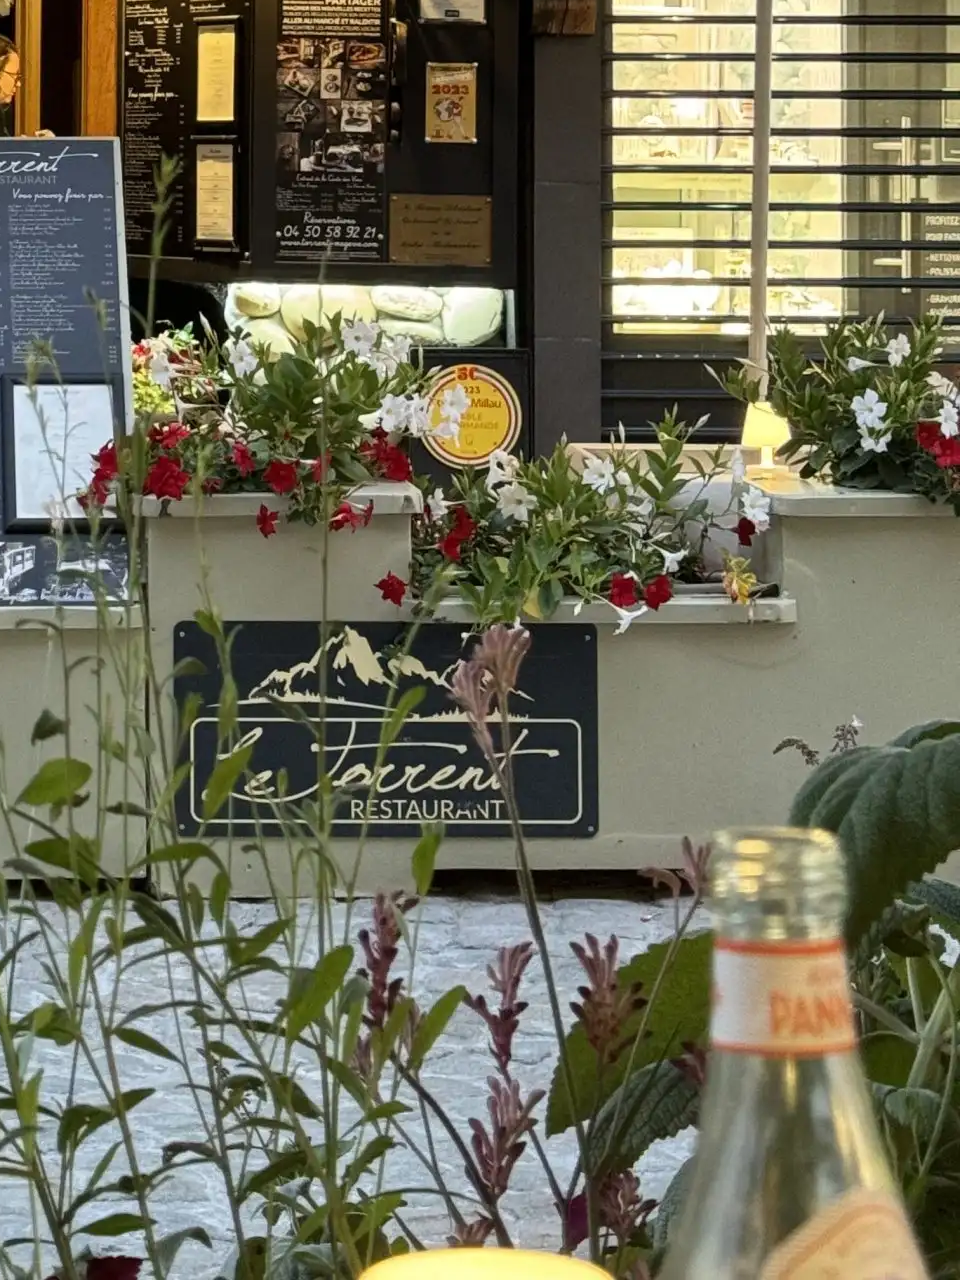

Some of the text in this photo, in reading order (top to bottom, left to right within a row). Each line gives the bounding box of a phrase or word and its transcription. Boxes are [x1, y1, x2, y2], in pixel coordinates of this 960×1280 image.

[283, 225, 376, 238] 04 50 58 92 21
